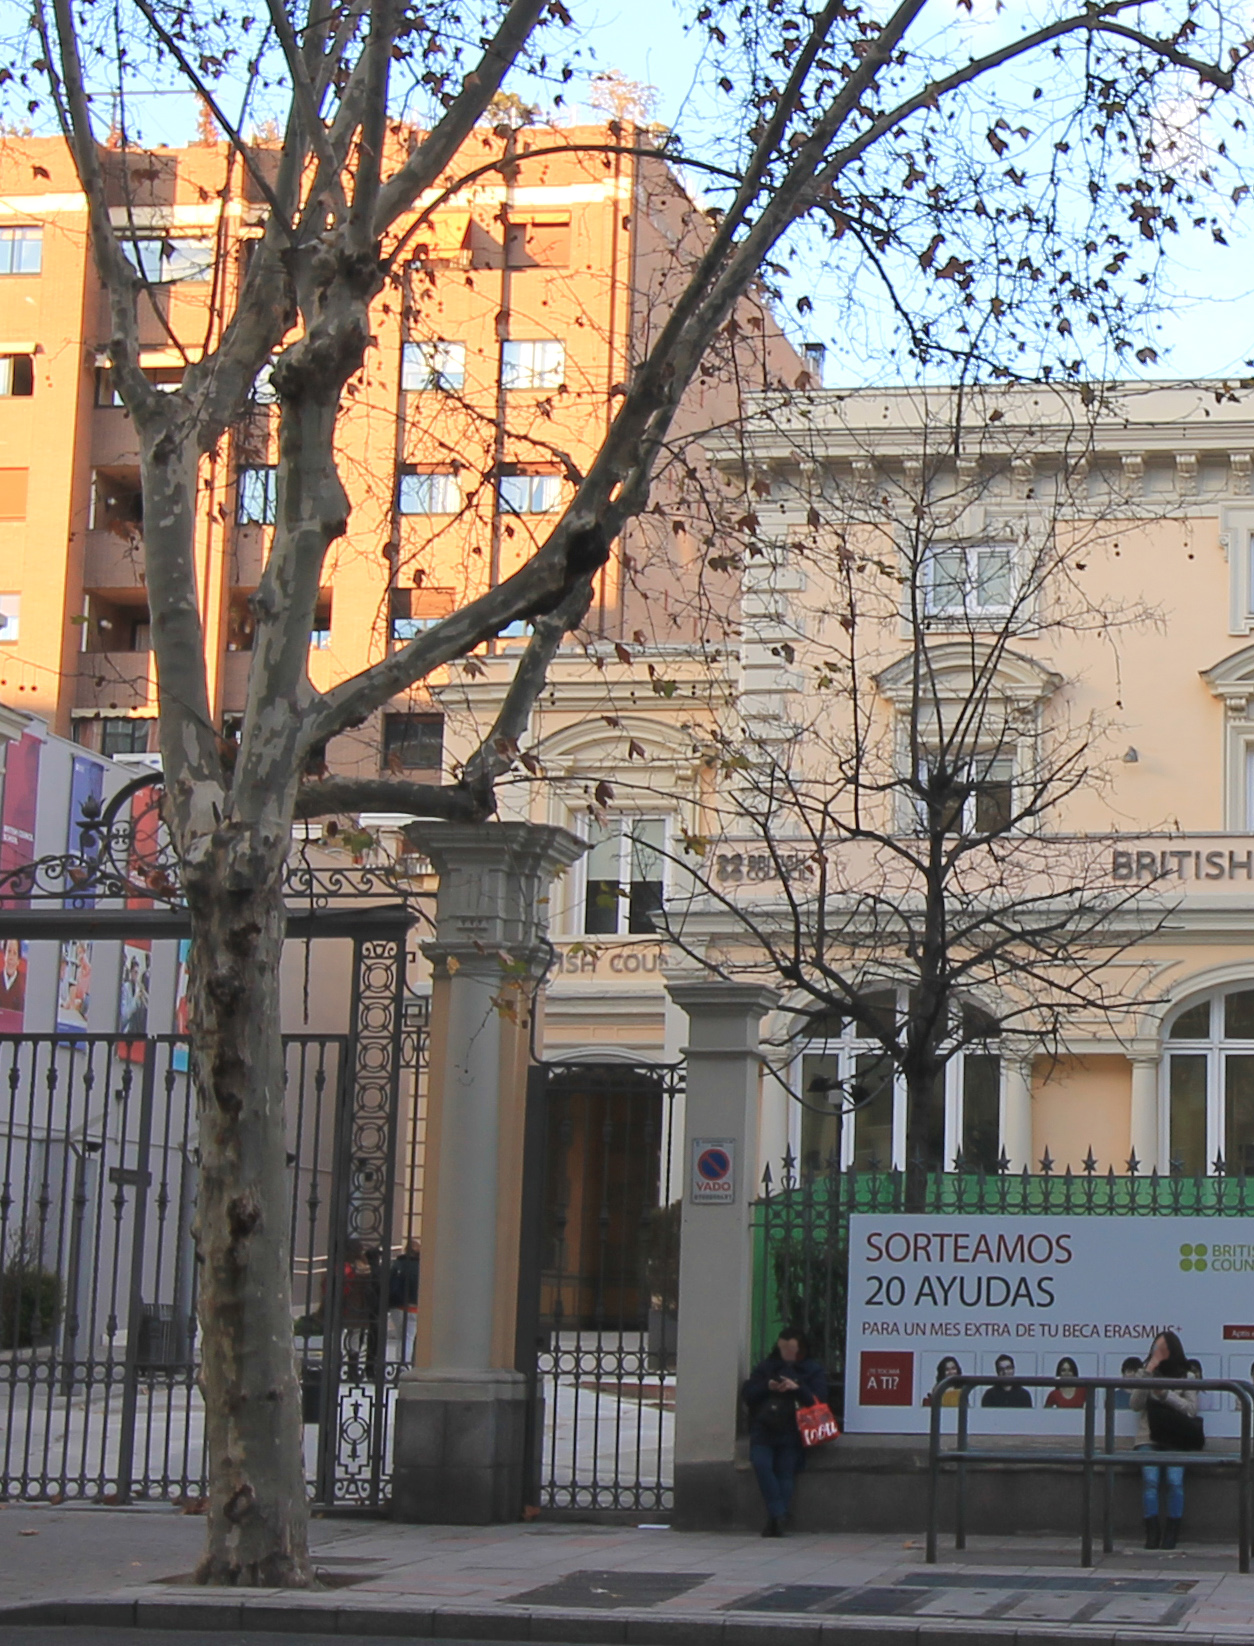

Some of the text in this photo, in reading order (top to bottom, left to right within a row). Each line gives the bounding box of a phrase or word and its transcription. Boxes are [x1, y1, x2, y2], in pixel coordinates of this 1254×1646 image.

[1112, 850, 1252, 880] BRITISH
[695, 1181, 732, 1192] VADO
[866, 1232, 1073, 1264] SORTEAMOS
[865, 1276, 1055, 1308] 20 AYUDAS
[862, 1321, 900, 1336] PARA
[904, 1322, 926, 1336] UN
[930, 1323, 961, 1337] MES
[964, 1323, 1012, 1338] EXTRA
[1016, 1324, 1035, 1338] DE
[1039, 1324, 1059, 1338] TU
[1062, 1324, 1100, 1338] BECA
[867, 1376, 900, 1390] A TI?
